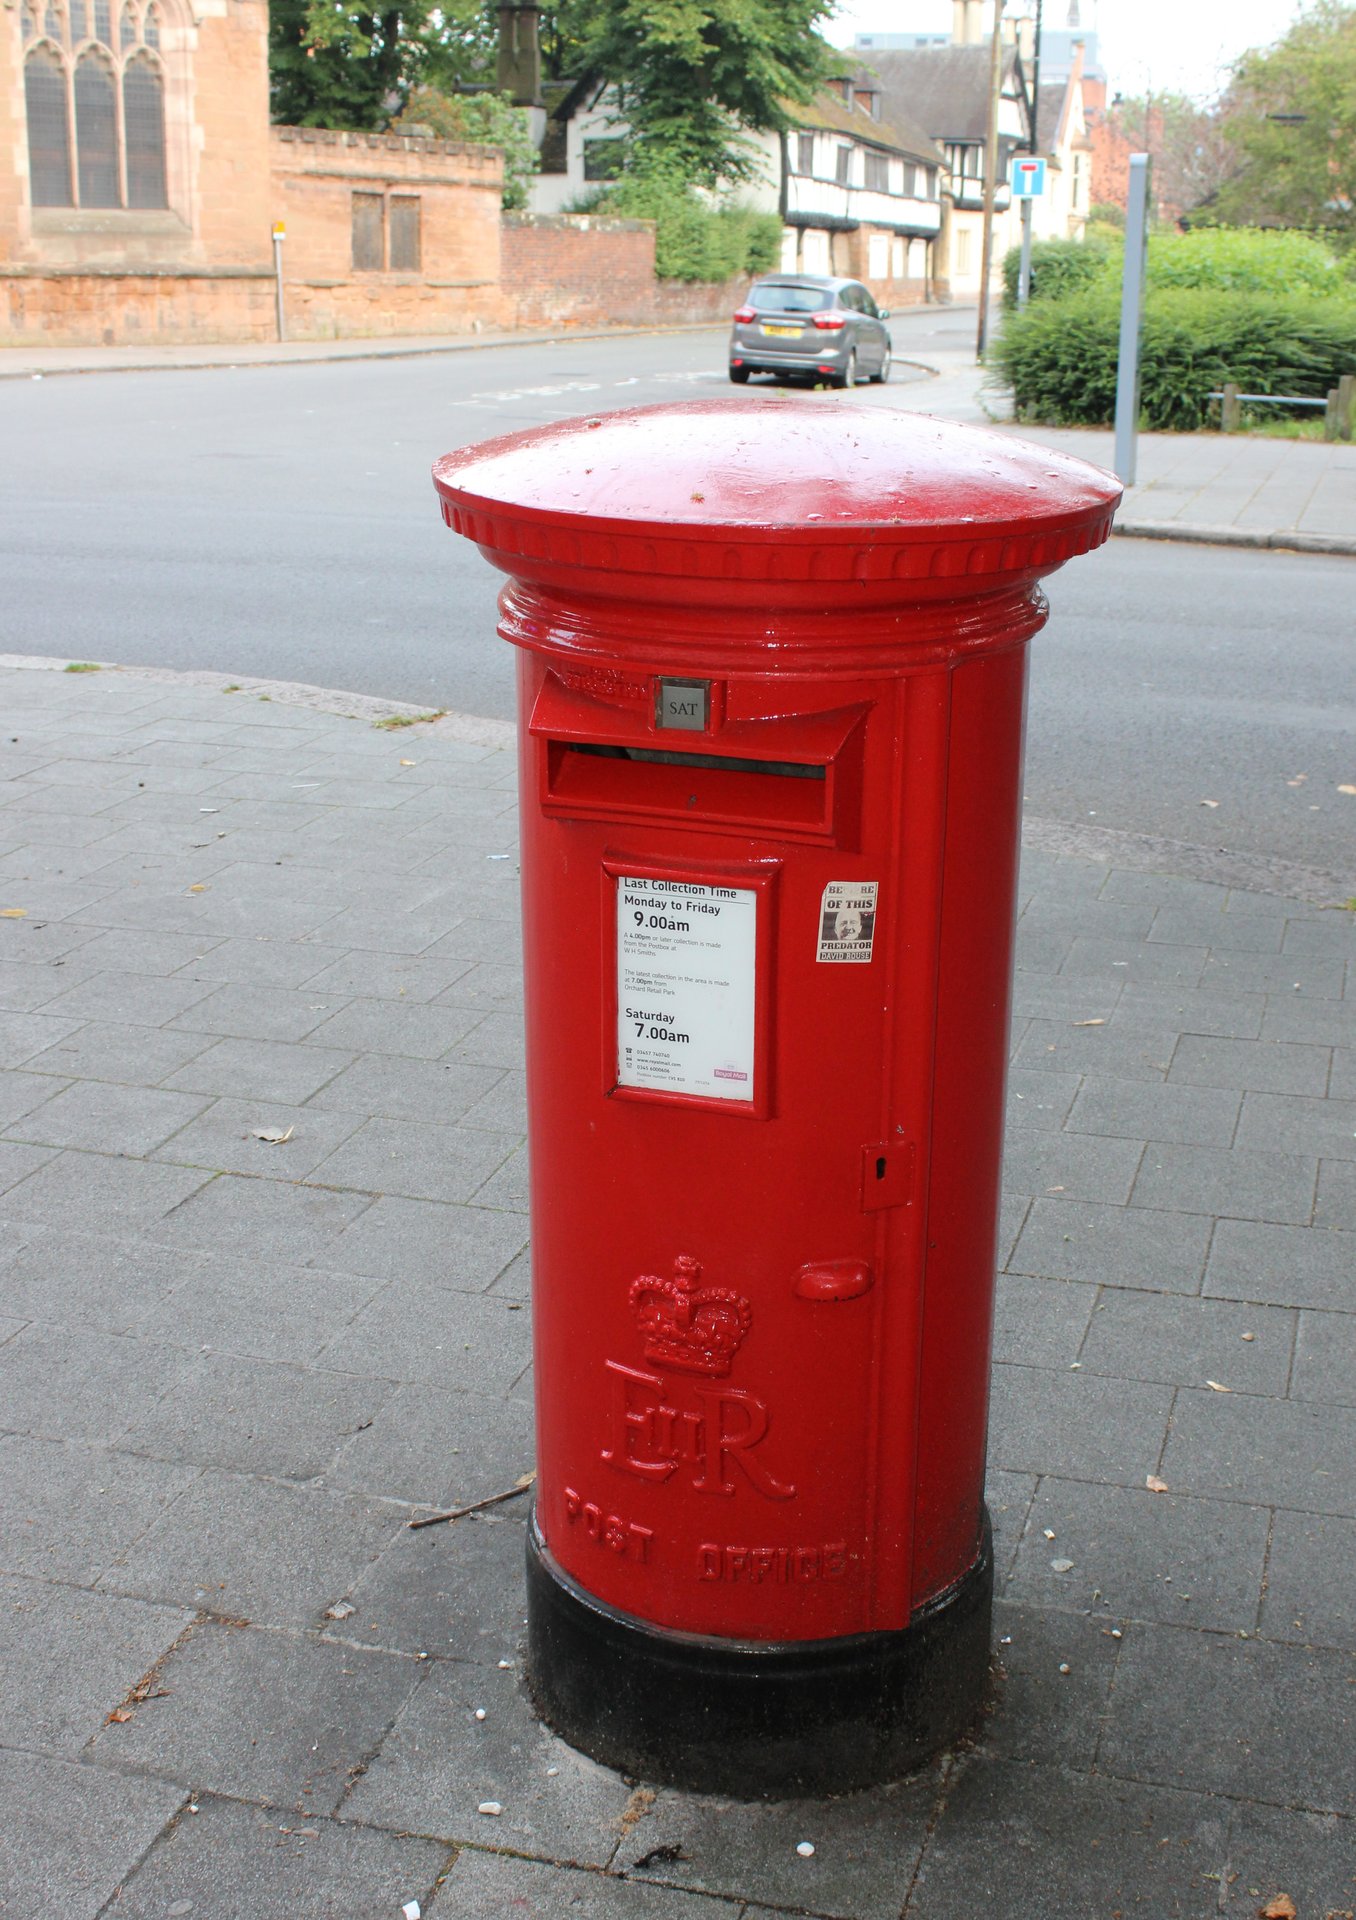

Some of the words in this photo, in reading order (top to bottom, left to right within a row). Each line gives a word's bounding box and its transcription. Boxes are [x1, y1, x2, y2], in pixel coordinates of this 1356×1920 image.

[670, 702, 698, 716] SAT
[624, 878, 648, 889] Last
[652, 880, 705, 895] Collection
[708, 887, 737, 898] Time
[624, 895, 667, 911] Monday
[671, 902, 682, 910] to
[686, 902, 721, 917] Friday
[827, 900, 842, 909] OF
[846, 900, 873, 909] THIS
[634, 911, 690, 932] 9.00am
[629, 933, 651, 941] 4.00pm
[674, 937, 698, 946] collection
[821, 942, 872, 950] PREDATOR
[648, 943, 670, 951] Postbox
[821, 952, 844, 960] DAVID
[846, 952, 870, 960] ROUSE
[631, 977, 653, 986] 7.00pm
[636, 970, 650, 978] latest
[652, 972, 676, 981] collection
[685, 975, 694, 983] the
[714, 979, 730, 987] made
[625, 985, 646, 993] Orchard
[625, 1008, 675, 1024] Saturday
[634, 1023, 690, 1043] 7.00am
[564, 1486, 655, 1564] POST
